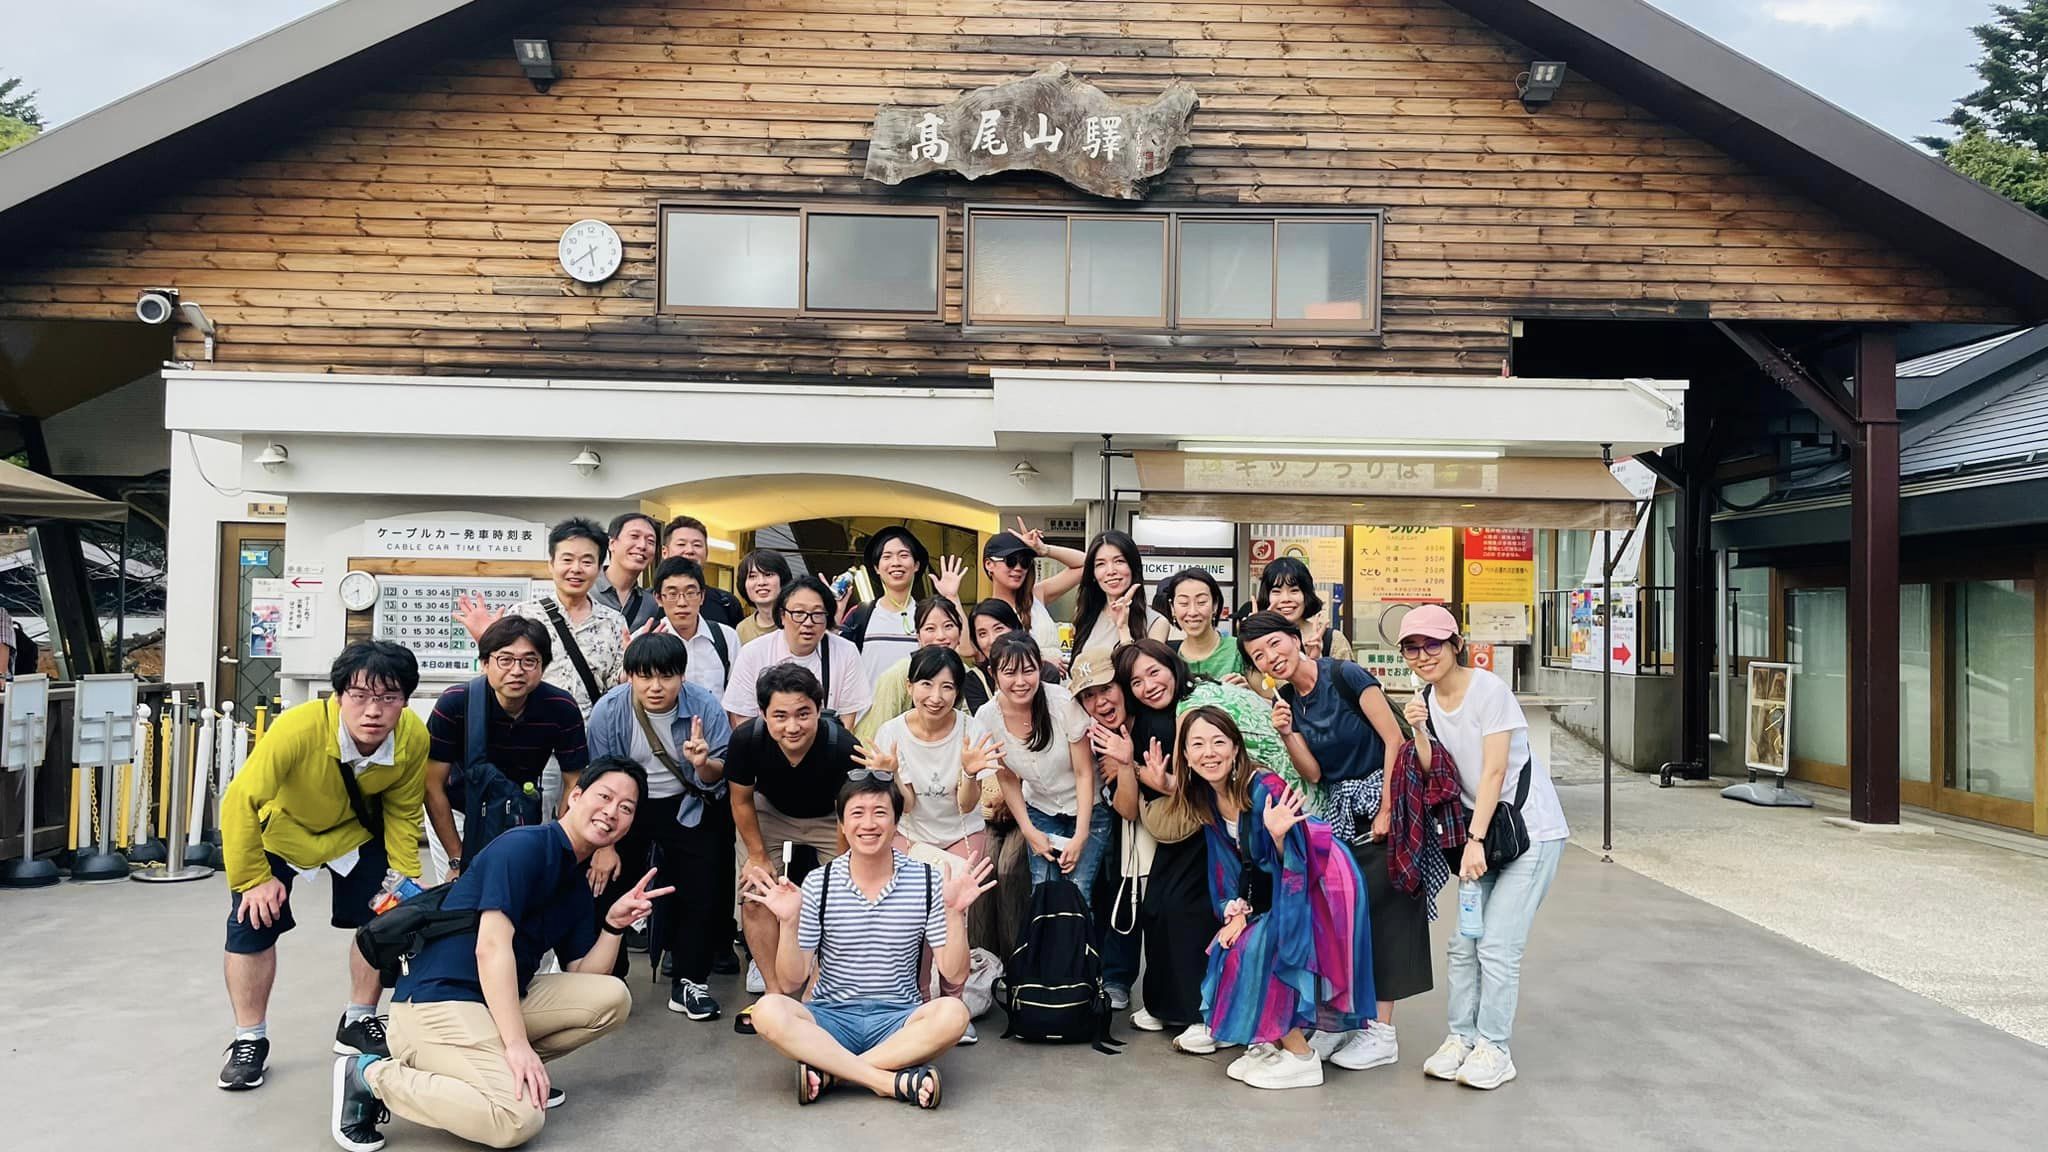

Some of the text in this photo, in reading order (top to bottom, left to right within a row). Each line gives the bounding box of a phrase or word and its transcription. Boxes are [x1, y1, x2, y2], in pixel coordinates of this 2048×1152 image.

[377, 528, 533, 541] ケーブルカー発車時刻表
[387, 543, 422, 551] CABLE
[456, 544, 481, 552] TIME
[489, 545, 523, 553] TABLE
[1360, 547, 1380, 556] 大人
[1360, 568, 1381, 577] こども
